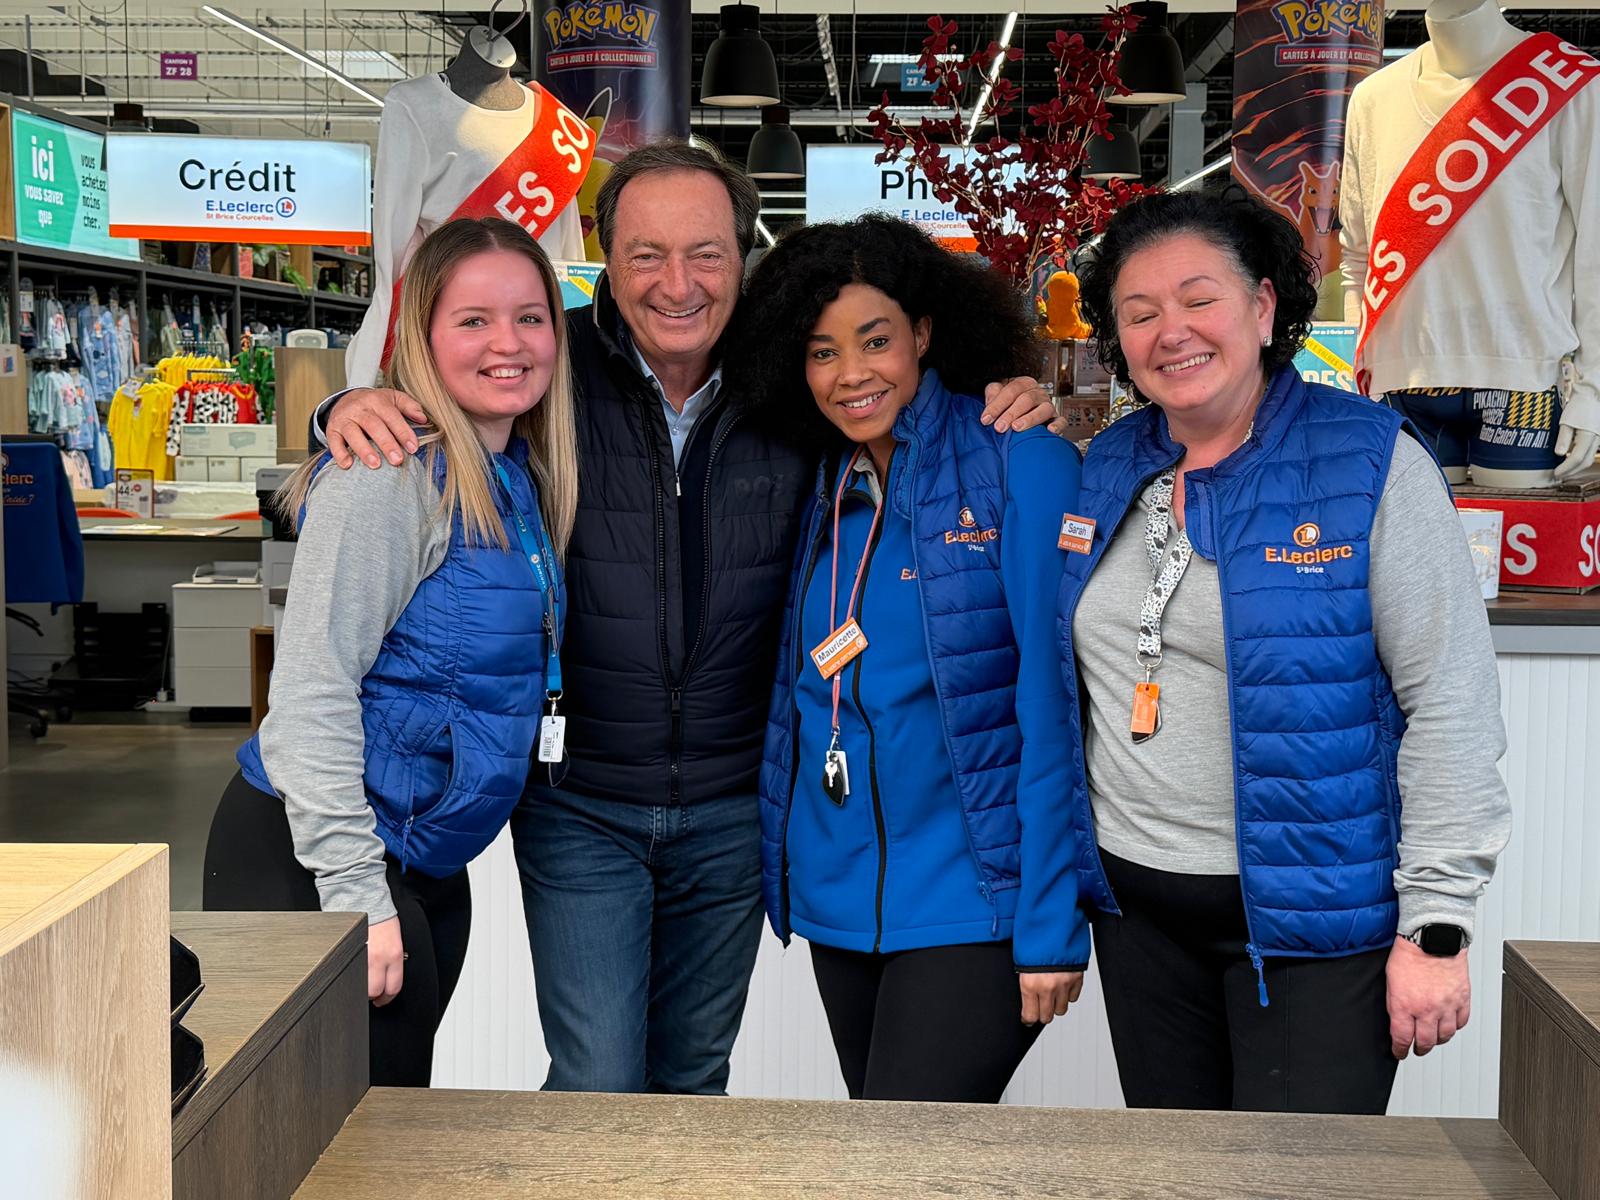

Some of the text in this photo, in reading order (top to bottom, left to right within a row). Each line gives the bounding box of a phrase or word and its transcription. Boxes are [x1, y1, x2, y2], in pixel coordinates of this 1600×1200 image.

[569, 54, 586, 64] JOUER
[586, 53, 593, 62] ET
[600, 53, 652, 63] COLLECTIONNER
[1282, 51, 1309, 60] CARTES
[1310, 48, 1316, 59] À
[1317, 50, 1338, 60] JOUER
[1339, 50, 1348, 59] ET
[1348, 49, 1353, 59] À
[1408, 41, 1600, 226] SOLDES
[31, 135, 55, 182] ici
[80, 154, 96, 169] vous
[81, 173, 107, 193] achetez
[179, 159, 296, 192] Crédit
[25, 184, 64, 206] vous savez
[82, 193, 101, 210] moins
[206, 199, 274, 213] E.Leclerc
[38, 209, 53, 229] que
[236, 213, 274, 221] Courcelles
[1473, 390, 1509, 410] PIKACHU
[1493, 427, 1519, 446] Catch
[944, 528, 998, 544] E.Leclerc
[1067, 522, 1088, 537] Sarah
[1265, 545, 1353, 564] E.Leclerc
[1304, 566, 1324, 574] Brice
